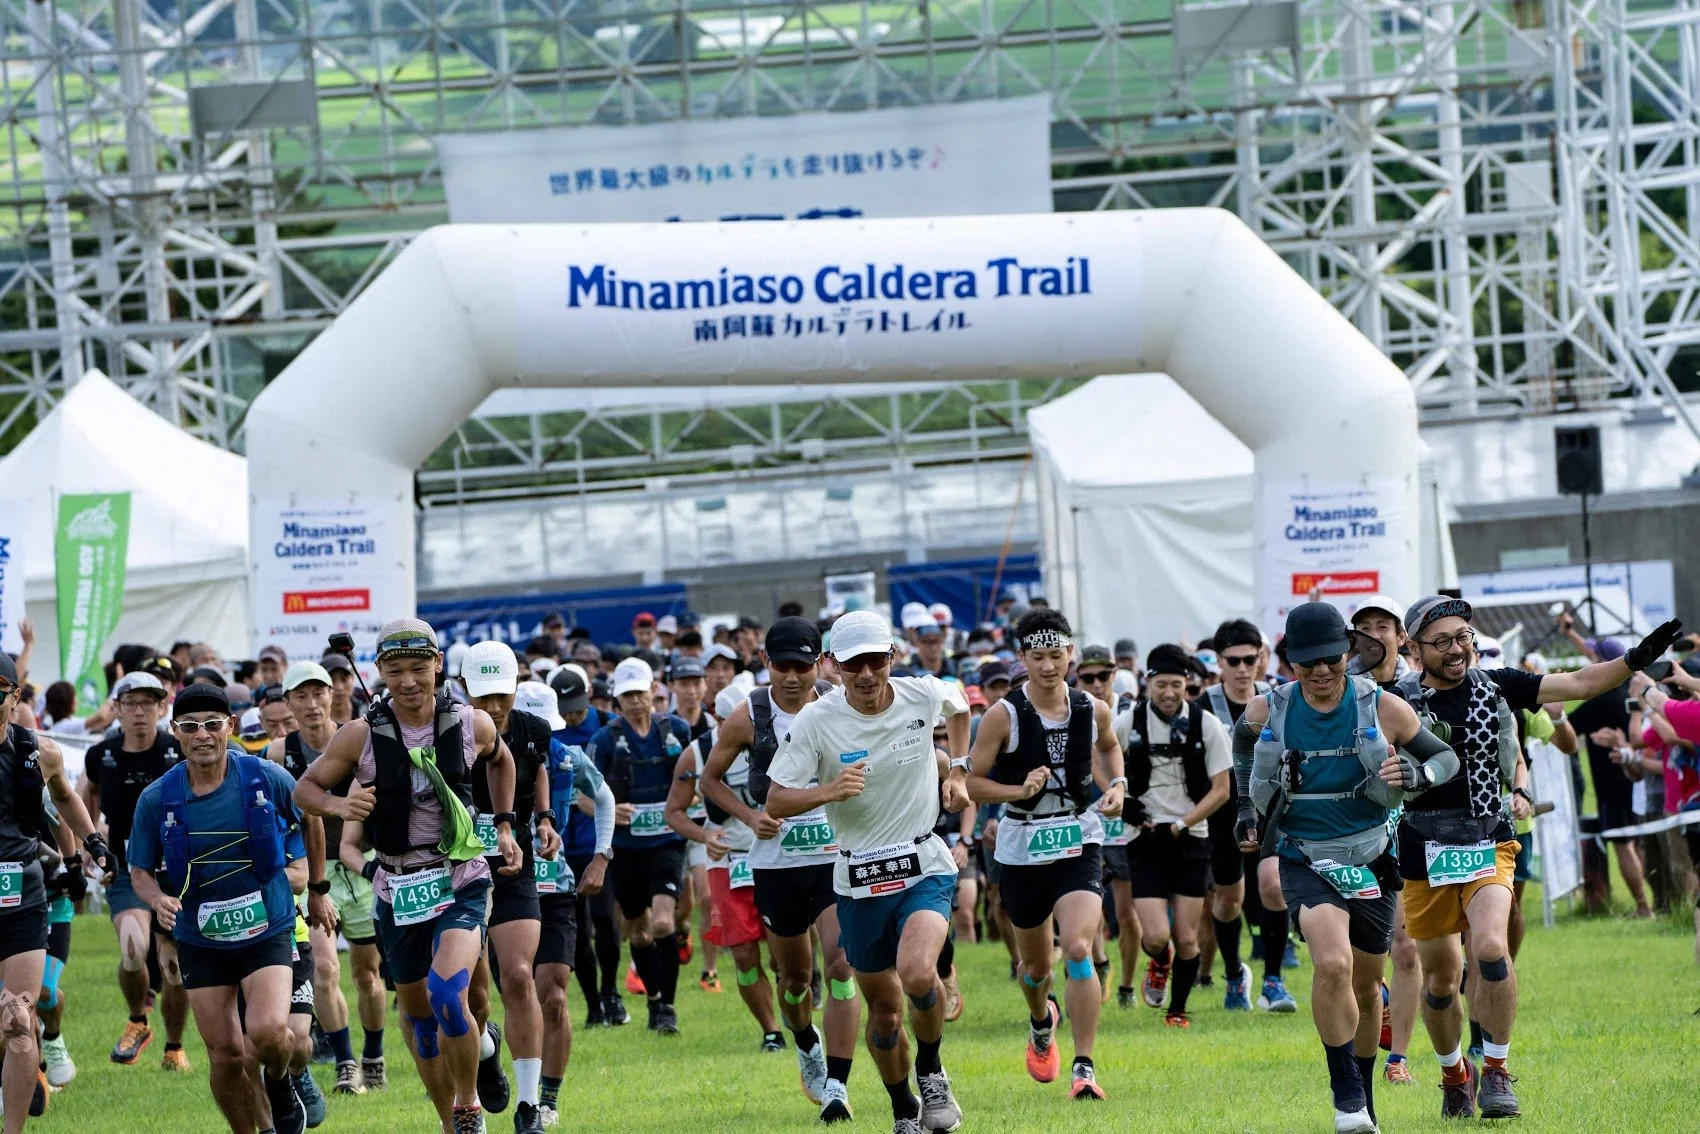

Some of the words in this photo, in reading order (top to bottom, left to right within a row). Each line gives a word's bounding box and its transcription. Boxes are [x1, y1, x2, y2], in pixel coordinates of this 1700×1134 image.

[567, 264, 804, 311] Minamiaso
[815, 262, 978, 304] Caldera
[987, 256, 1094, 299] Trail
[692, 307, 973, 343] 南阿蘇カルデラトレイル
[1294, 506, 1378, 521] Minamiaso
[283, 522, 367, 539] Minamiaso
[1285, 525, 1345, 541] Caldera
[1348, 521, 1386, 537] Trail
[275, 541, 334, 558] Caldera
[336, 538, 376, 554] Trail
[1023, 633, 1059, 644] NORTH
[1031, 641, 1059, 649] FACE
[481, 665, 500, 674] BIX
[640, 812, 663, 825] 139
[479, 826, 498, 841] 53
[792, 825, 831, 841] 1413
[1036, 828, 1072, 846] 1371
[878, 847, 897, 855] Caldera
[1440, 852, 1484, 868] 1330
[855, 864, 881, 879] 森本
[885, 858, 912, 872] 幸司
[862, 876, 892, 885] MORIMOTO
[398, 882, 440, 907] 1436
[199, 914, 208, 922] 50
[211, 907, 255, 929] 1490
